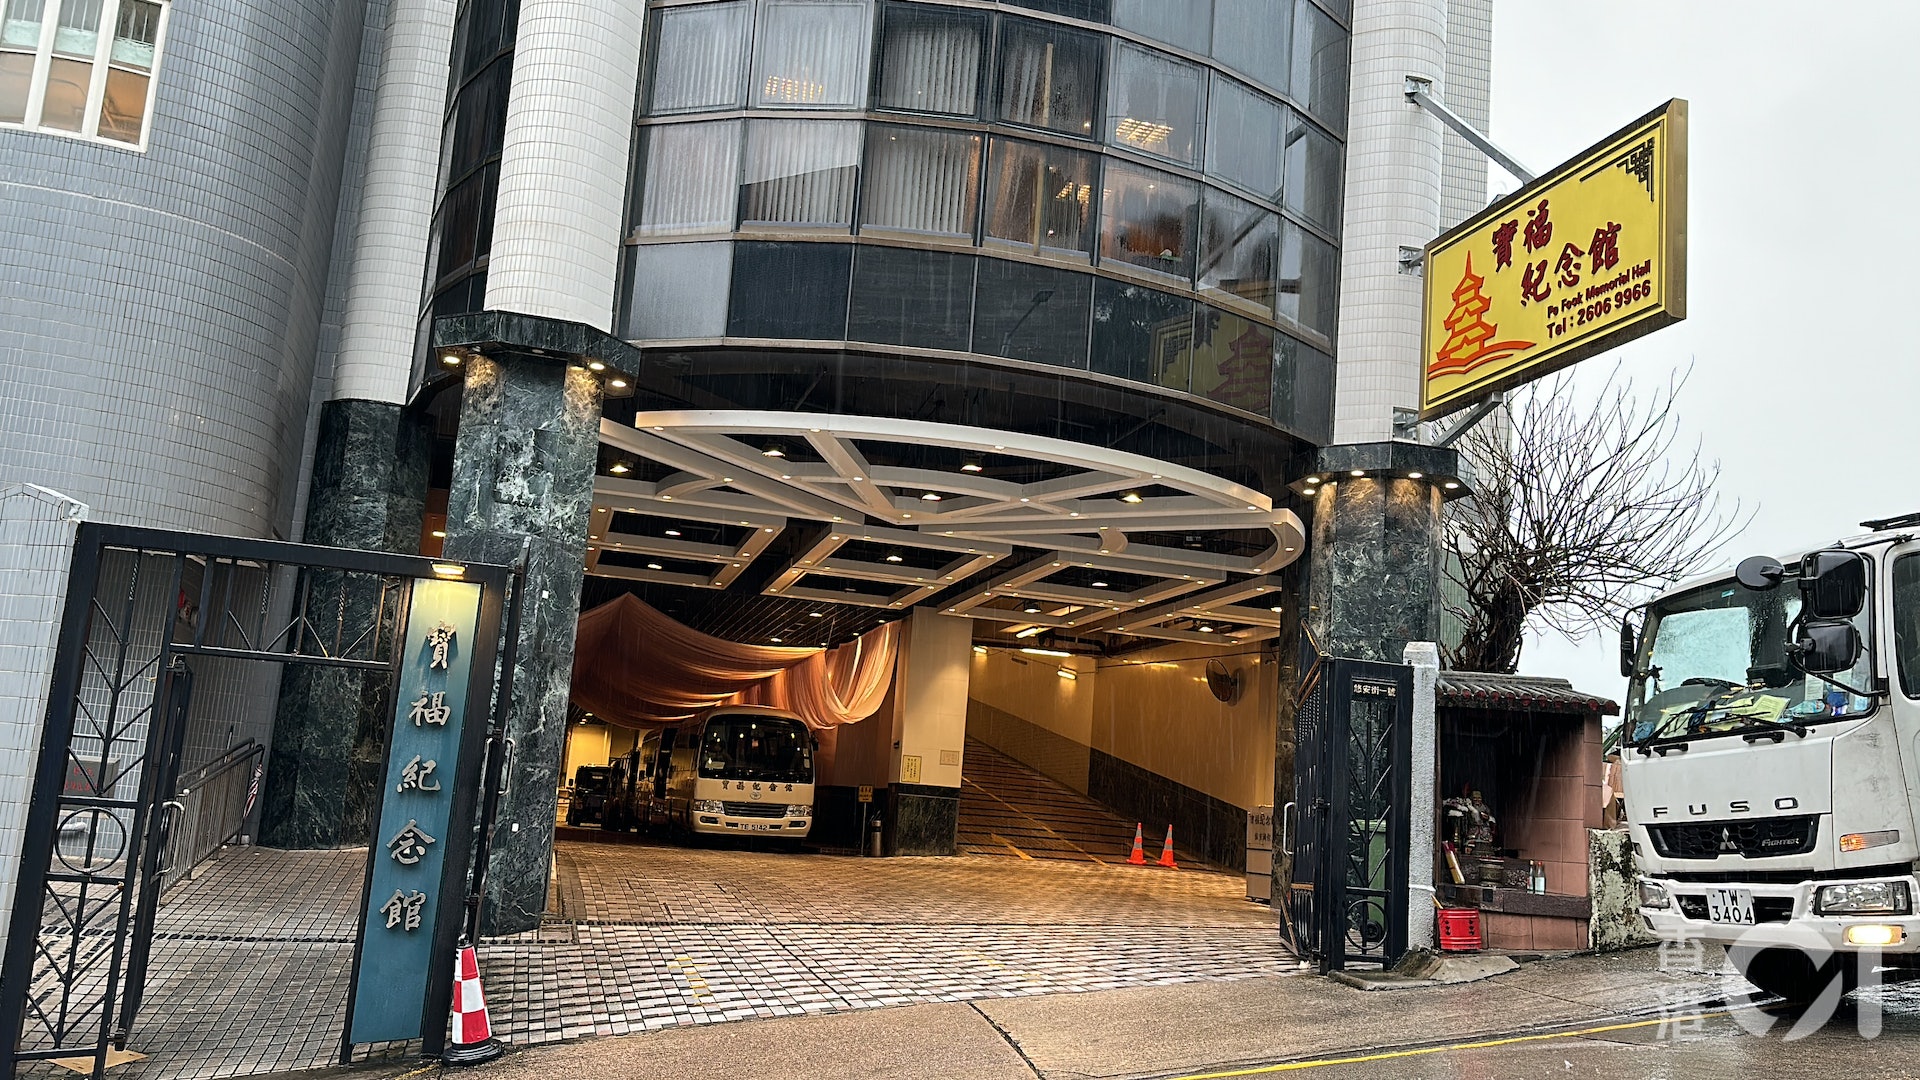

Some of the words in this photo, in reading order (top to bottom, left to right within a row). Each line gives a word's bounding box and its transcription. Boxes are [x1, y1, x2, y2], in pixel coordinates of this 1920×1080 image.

[1492, 199, 1553, 272] 寶福
[1520, 221, 1622, 307] 紀念館
[1547, 304, 1559, 319] Po
[1561, 292, 1583, 312] Fook
[1586, 268, 1630, 299] Memorial
[1632, 259, 1651, 281] Hall
[1577, 297, 1612, 326] 2606
[1614, 279, 1651, 309] 9966
[380, 620, 457, 931] 寶福紀念館
[1652, 796, 1799, 818] FUSO
[1711, 905, 1753, 923] 3404
[1717, 889, 1739, 906] TW
